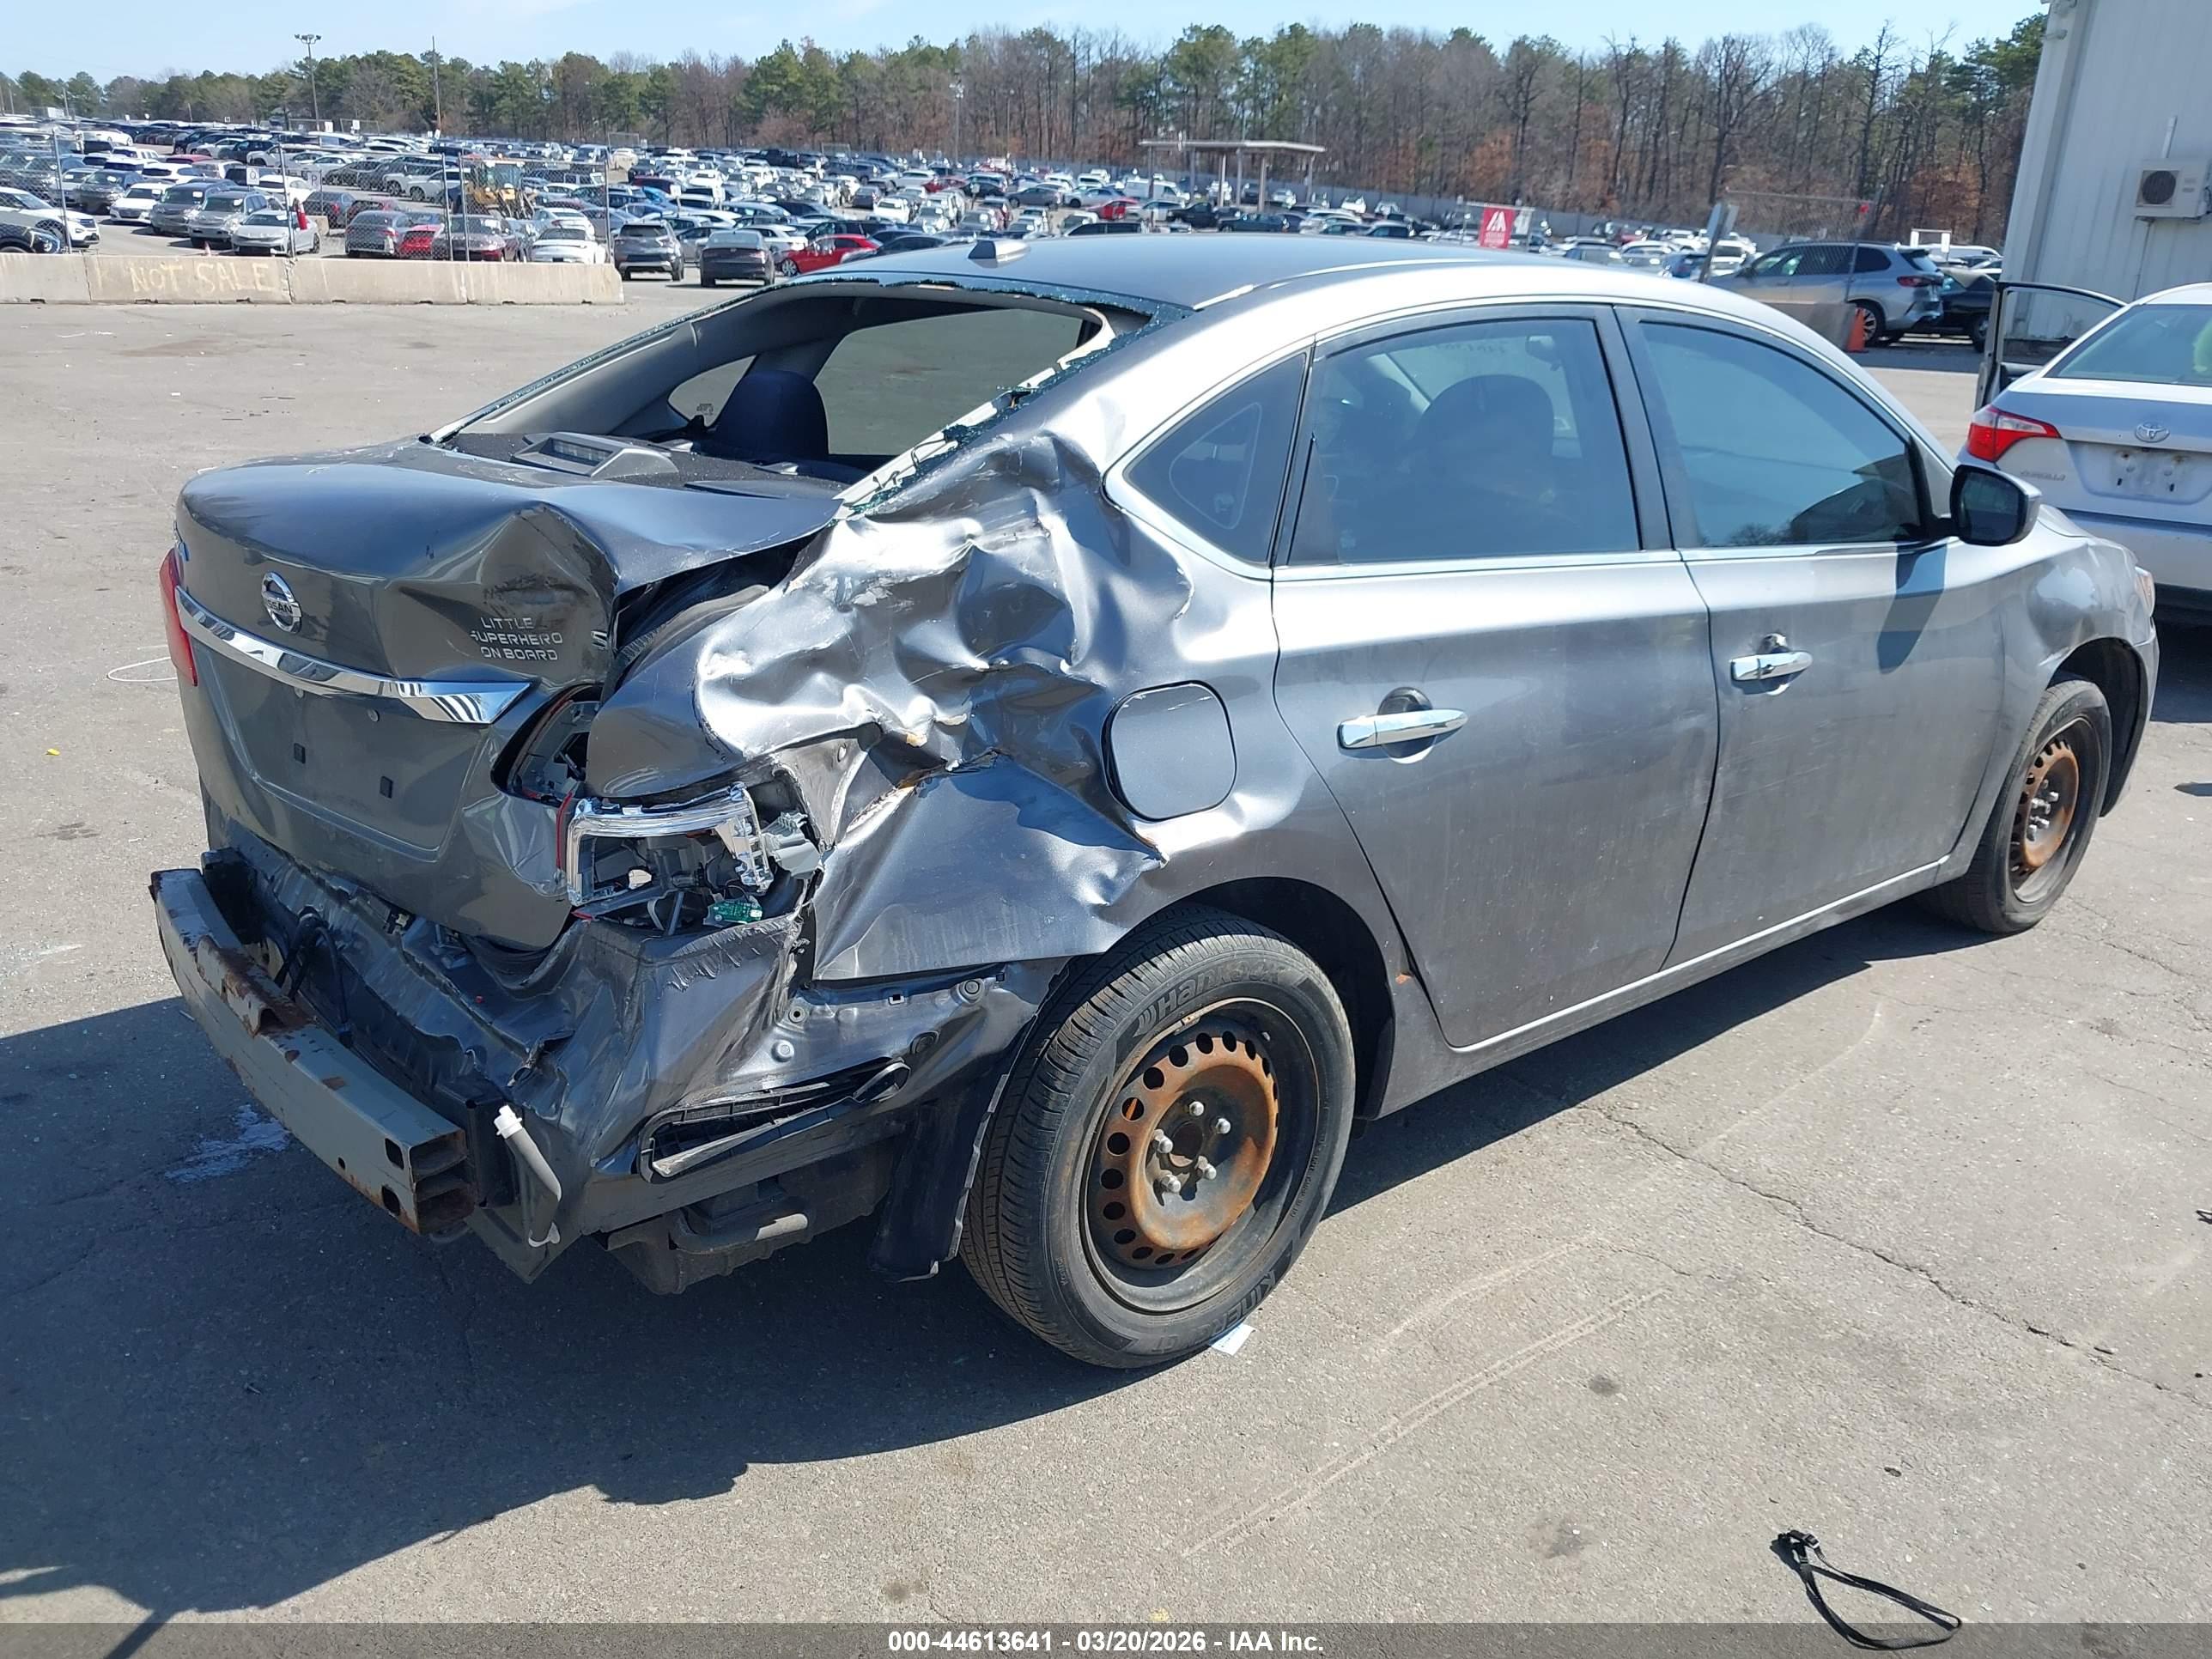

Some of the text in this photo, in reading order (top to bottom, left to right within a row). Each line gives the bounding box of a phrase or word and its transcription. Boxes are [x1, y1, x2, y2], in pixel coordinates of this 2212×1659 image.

[130, 259, 275, 294] NOT SALE
[481, 617, 535, 629] LITTLE
[480, 647, 558, 660] ON BOARD
